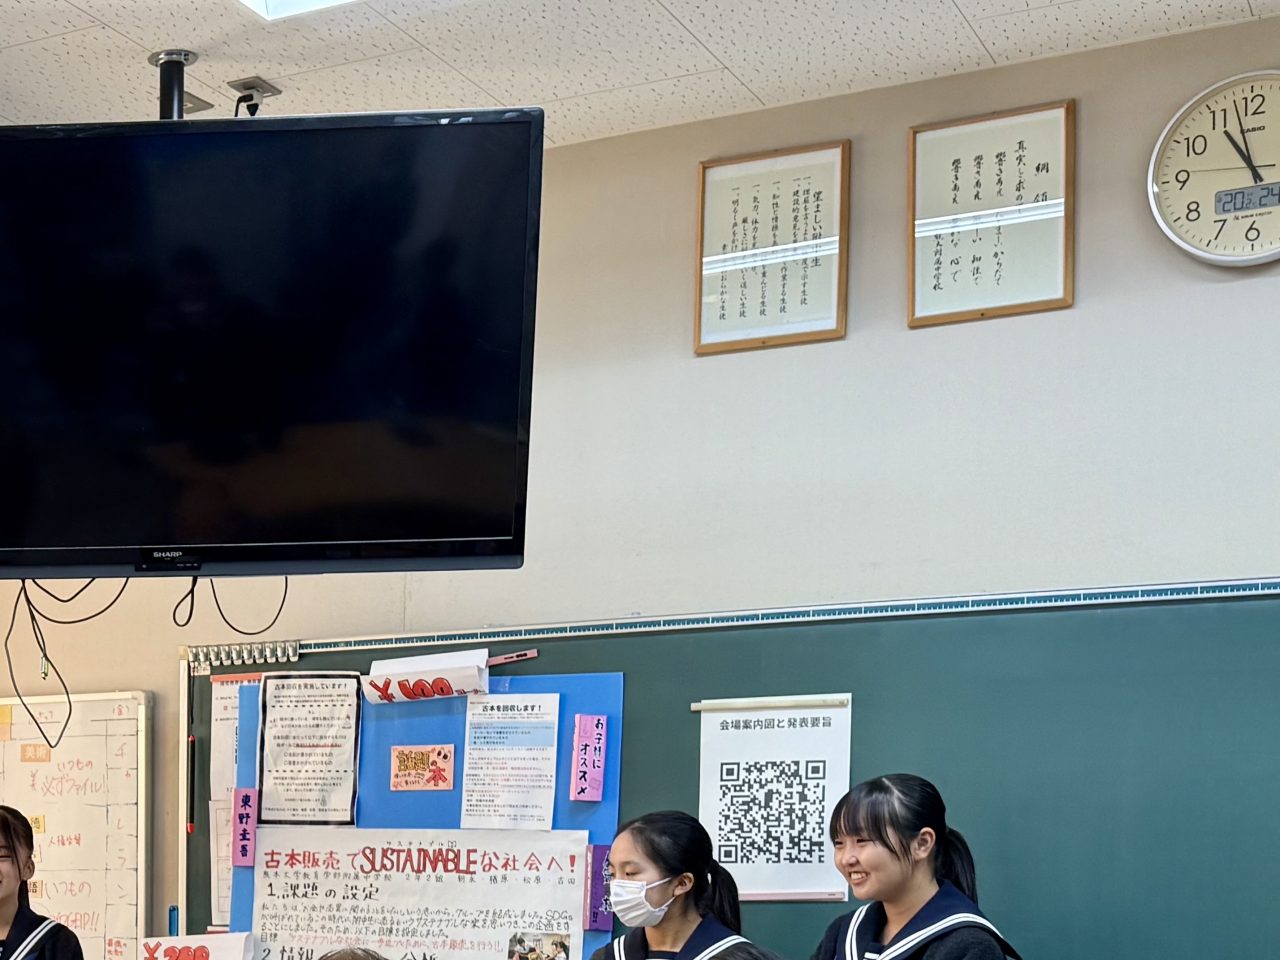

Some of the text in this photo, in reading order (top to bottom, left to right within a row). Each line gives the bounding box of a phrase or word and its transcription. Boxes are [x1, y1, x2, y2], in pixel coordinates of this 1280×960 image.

[1242, 94, 1266, 117] 12
[1210, 108, 1227, 131] 11
[1184, 134, 1207, 158] 10
[1175, 169, 1191, 191] 9
[1185, 201, 1201, 222] 8
[1213, 218, 1228, 241] 7
[1245, 220, 1261, 242] 6
[719, 716, 832, 731] 会場案内図と発表要旨
[577, 743, 590, 796] オススメ
[30, 817, 41, 830] 徳
